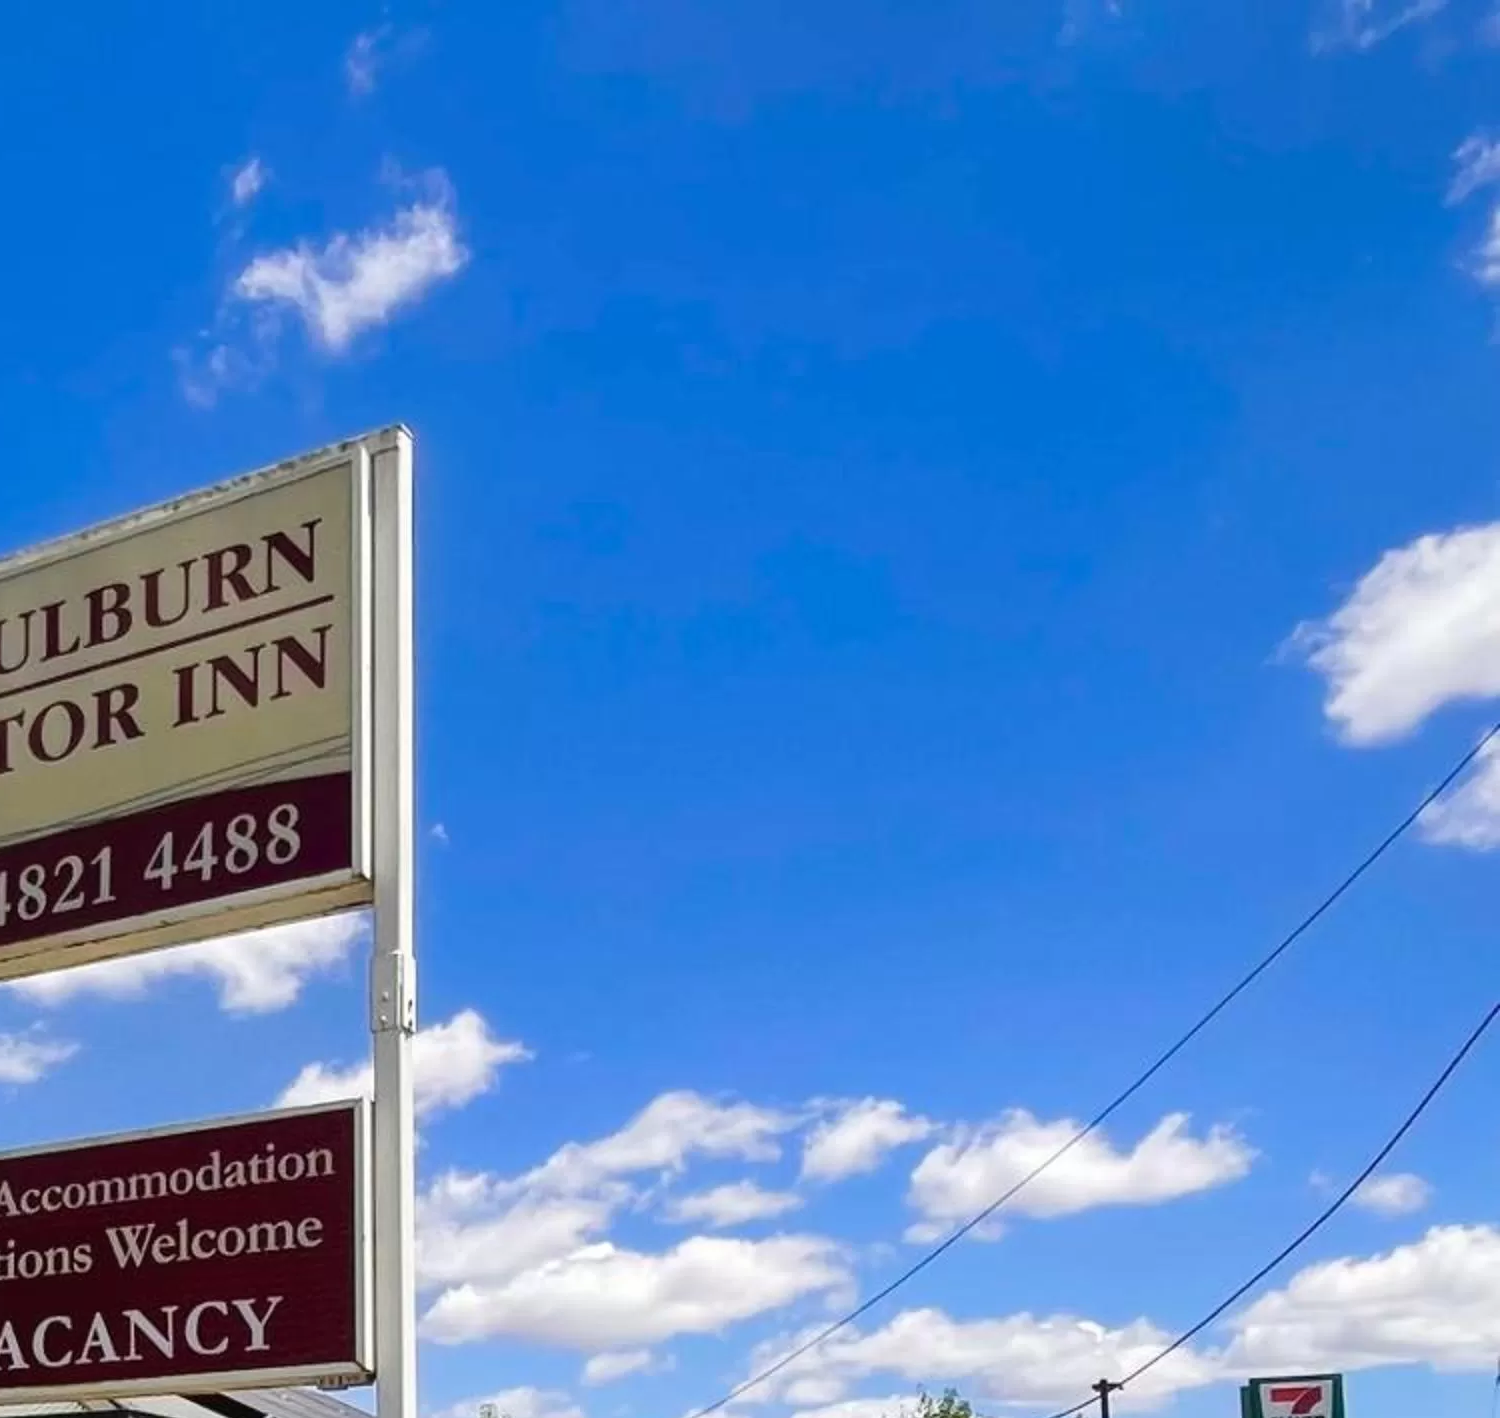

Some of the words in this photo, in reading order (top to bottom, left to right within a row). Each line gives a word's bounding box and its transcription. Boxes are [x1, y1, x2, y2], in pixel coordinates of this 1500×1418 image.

[172, 624, 333, 729] INN
[143, 803, 302, 890] 4488
[105, 1216, 324, 1270] Welcome
